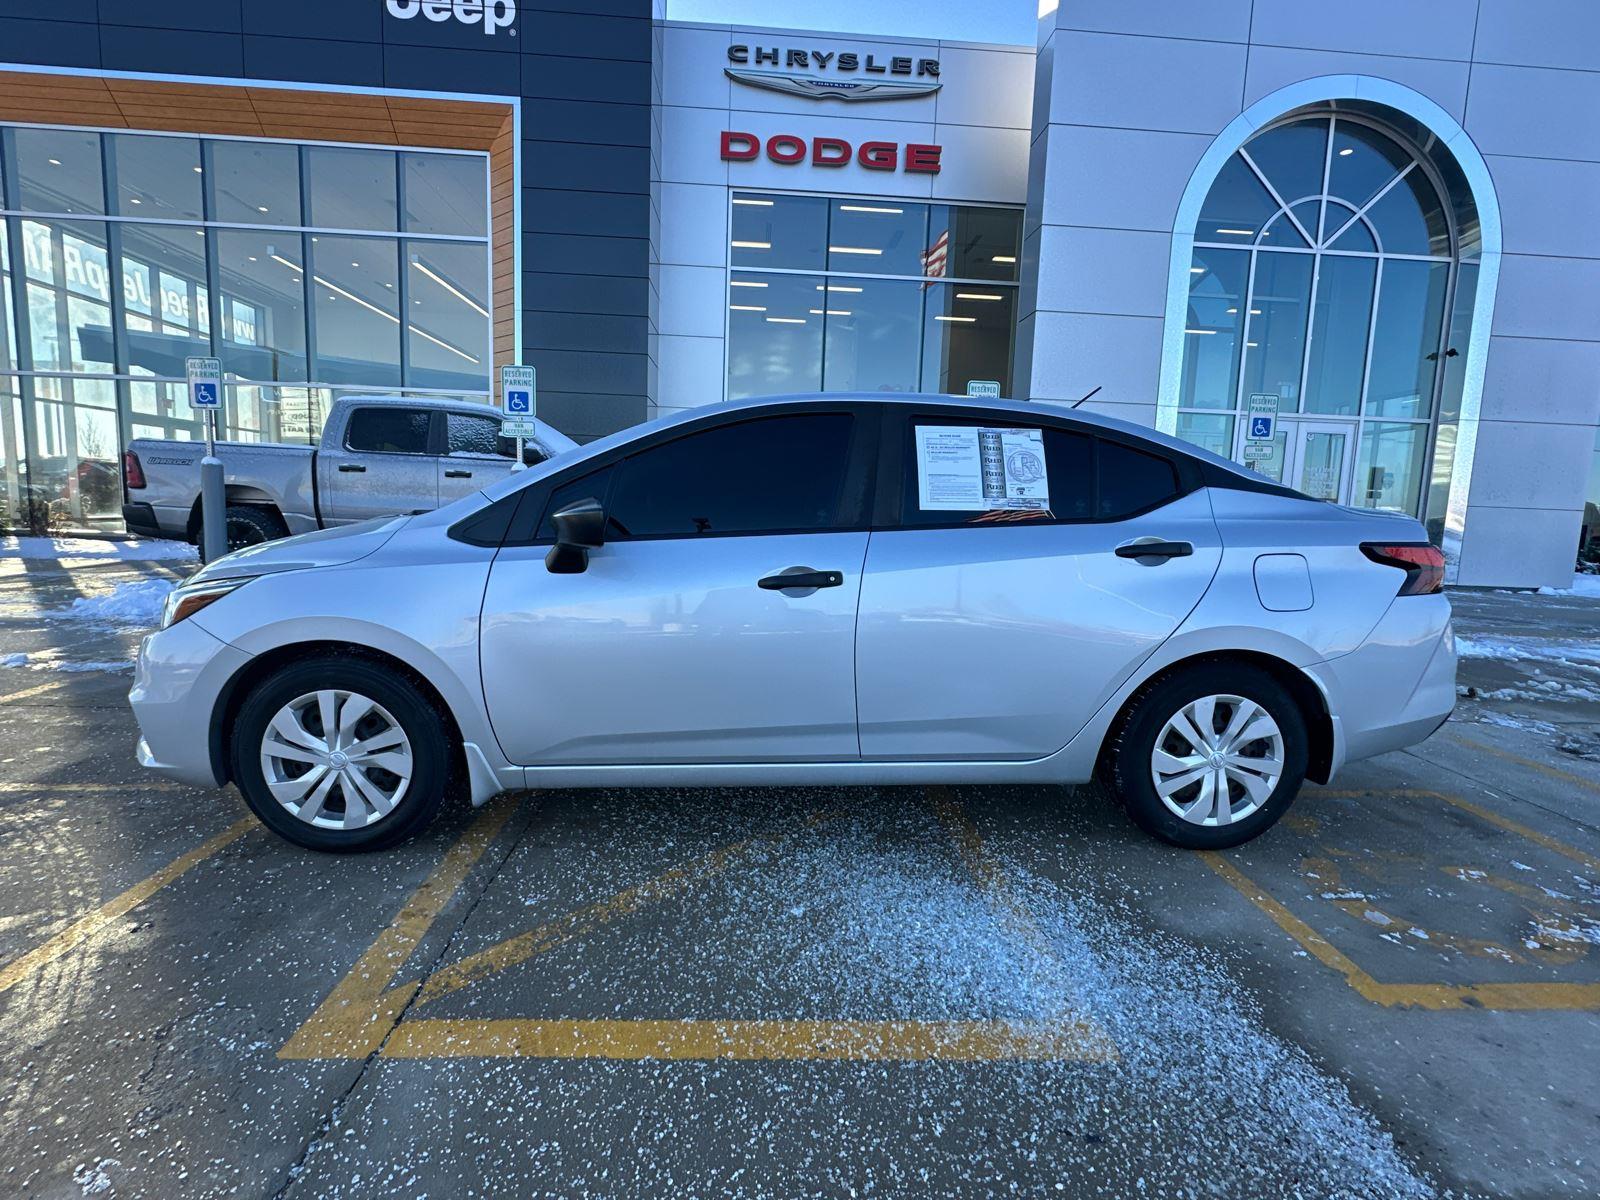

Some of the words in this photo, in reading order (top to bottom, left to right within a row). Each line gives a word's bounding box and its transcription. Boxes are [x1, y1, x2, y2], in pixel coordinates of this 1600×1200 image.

[727, 44, 941, 76] CHRYSLER
[720, 131, 943, 174] DODGE
[190, 361, 219, 369] RESERVED
[190, 370, 218, 378] PARKING
[504, 370, 532, 378] RESERVED
[504, 379, 532, 387] PARKING
[971, 385, 997, 393] RESERVED
[1251, 397, 1277, 406] RESERVED
